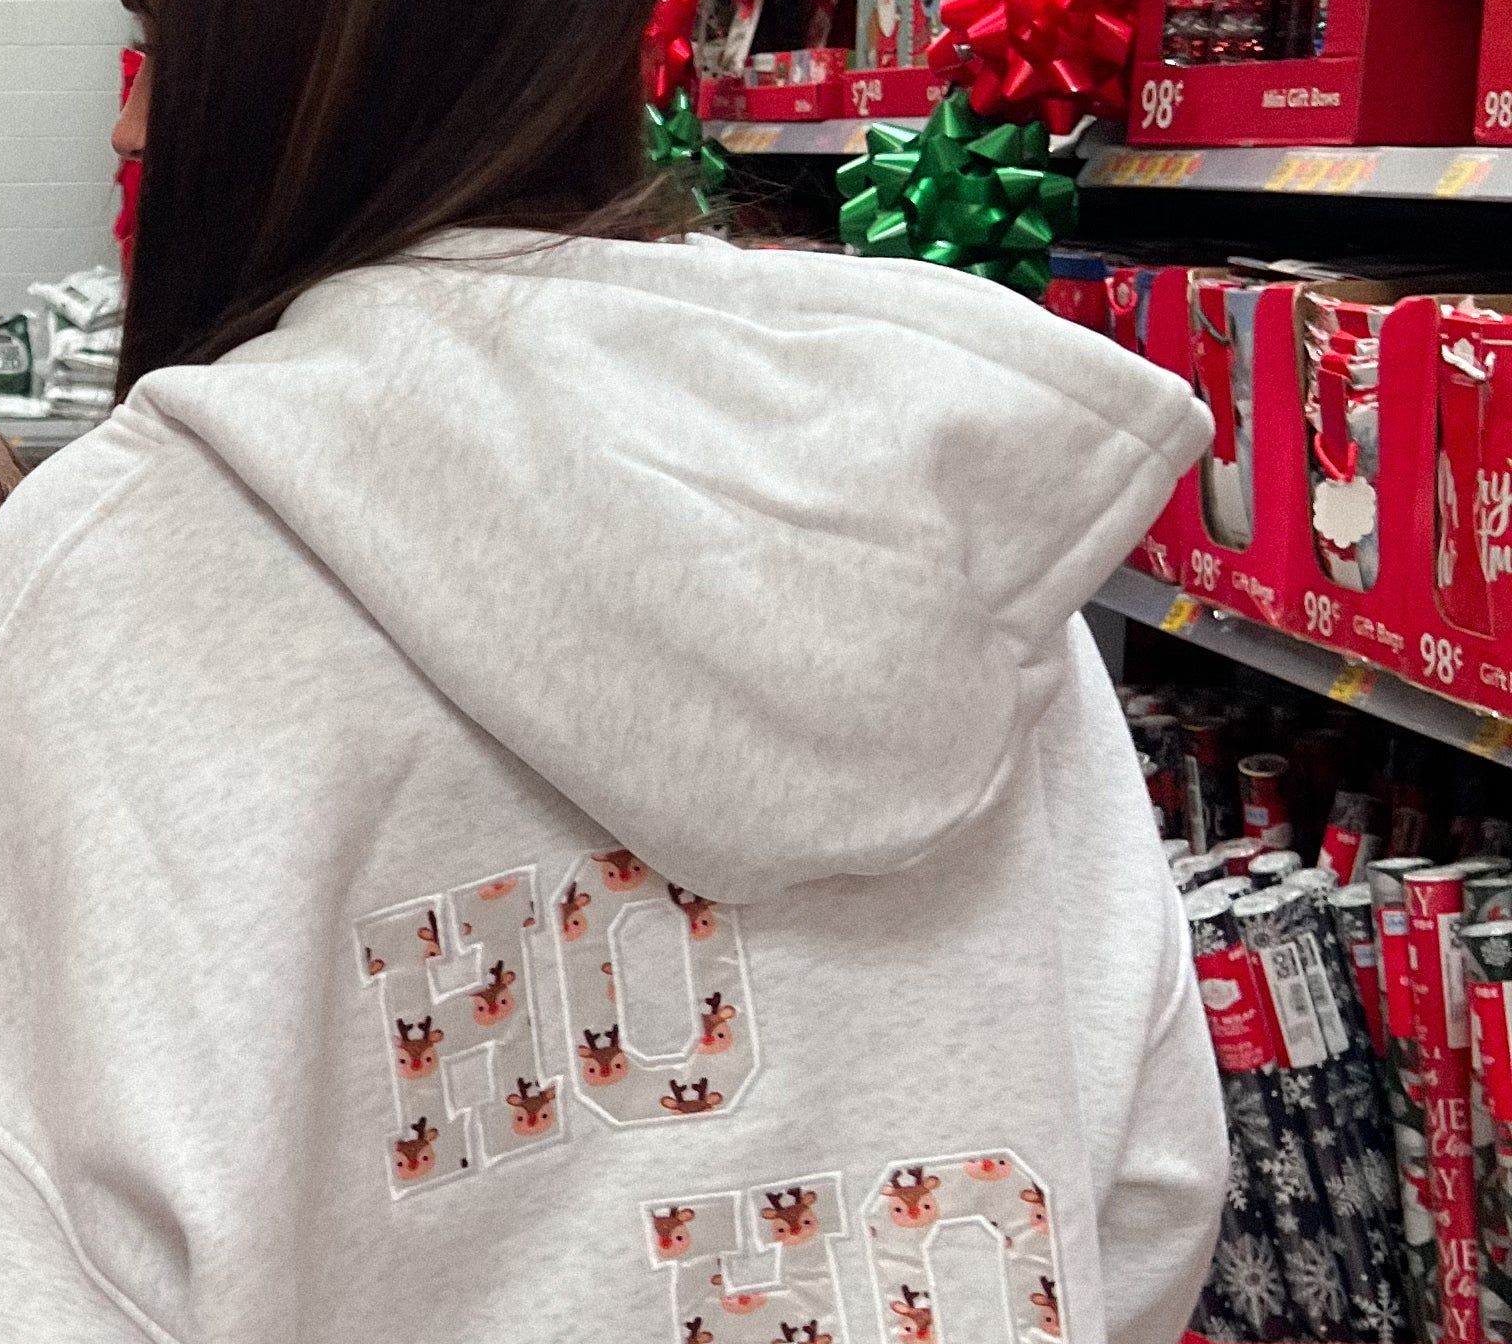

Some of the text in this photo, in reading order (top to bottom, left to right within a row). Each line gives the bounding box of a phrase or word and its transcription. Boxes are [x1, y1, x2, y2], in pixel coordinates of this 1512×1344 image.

[1141, 79, 1184, 129] 98¢
[1191, 548, 1222, 592] 98¢
[1303, 590, 1343, 638] 98¢
[1420, 632, 1464, 685] 98¢
[354, 849, 761, 1203] HO
